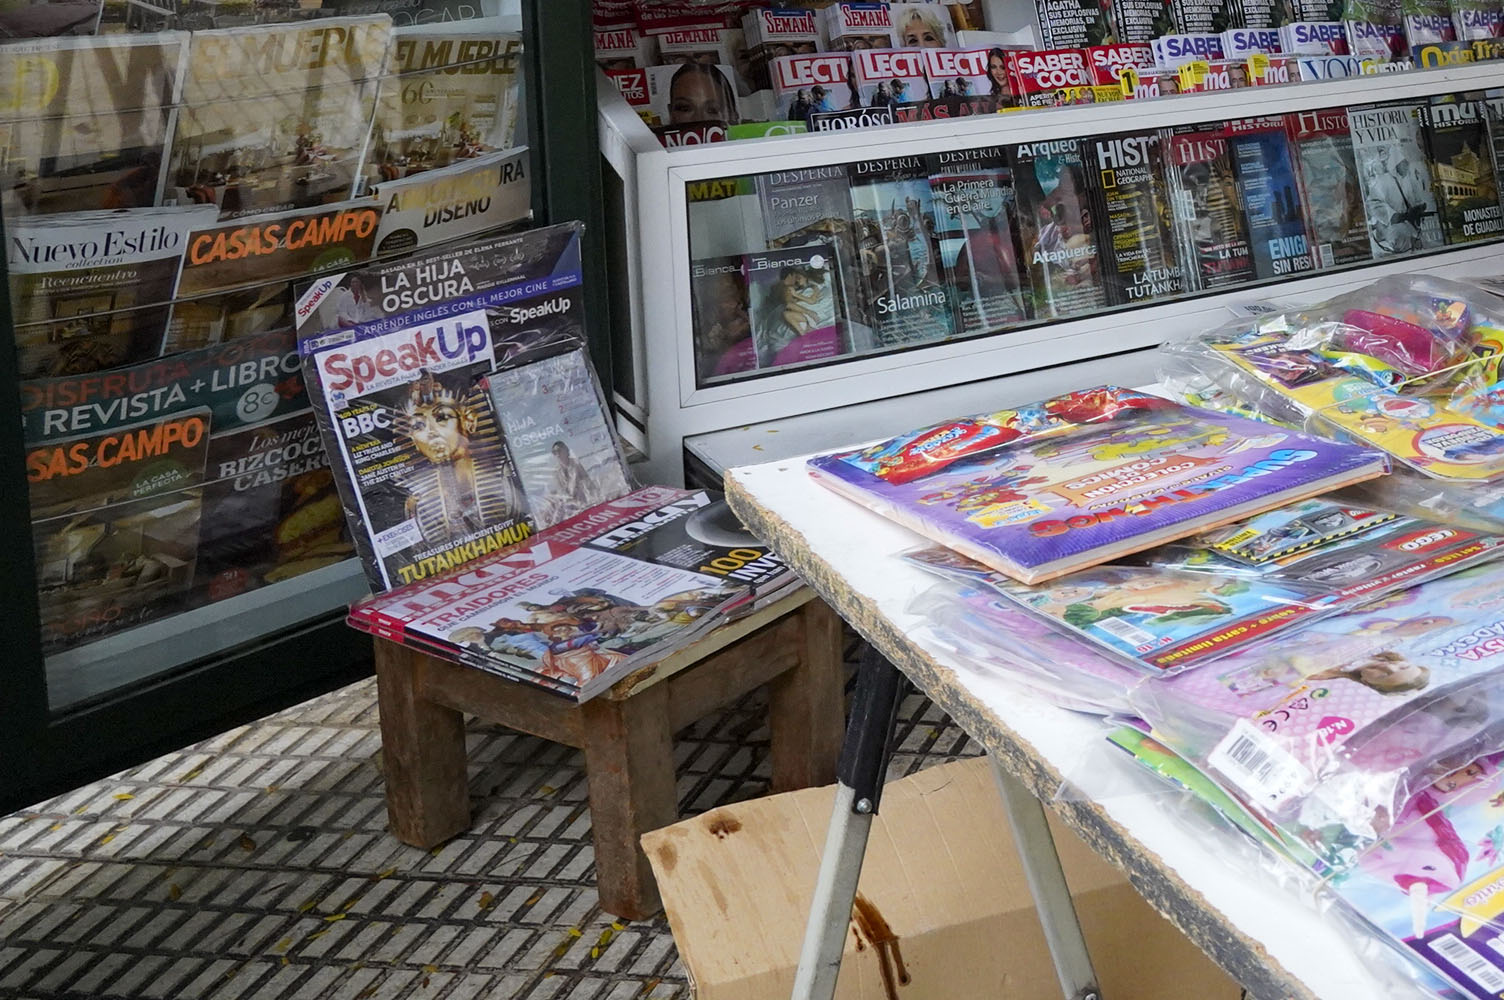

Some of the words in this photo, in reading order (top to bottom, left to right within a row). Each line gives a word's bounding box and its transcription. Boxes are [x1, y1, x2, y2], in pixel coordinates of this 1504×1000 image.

[841, 3, 891, 28] SEMANA
[1048, 0, 1081, 11] ÁGATHA
[1049, 10, 1063, 20] SUS
[764, 11, 817, 35] SEMANA
[420, 40, 520, 77] MUEBLE
[1017, 53, 1083, 76] SABER
[1352, 113, 1409, 132] HISTORIA
[1364, 126, 1402, 146] VIDA
[770, 192, 819, 210] Panzer
[9, 237, 99, 265] Nuevo
[103, 225, 179, 258] Estilo
[190, 224, 281, 266] CASAS
[285, 209, 377, 250] CAMPO
[380, 274, 410, 295] LA
[415, 258, 466, 286] HIJA
[756, 257, 802, 270] Bianca
[298, 279, 333, 318] SpeakUp
[362, 314, 412, 336] APRENDE
[413, 305, 450, 323] INGLÉS
[450, 300, 474, 314] CON
[476, 297, 488, 308] EL
[489, 288, 524, 304] MEJOR
[525, 280, 549, 295] CINE
[382, 279, 476, 313] OSCURA
[509, 296, 571, 325] SpeakUp
[876, 290, 947, 315] Salamina
[324, 321, 487, 395] SpeakUp
[43, 383, 186, 436] REVISTA
[341, 408, 392, 439] BBC
[96, 416, 204, 469] CAMPO
[1188, 448, 1318, 493] SUPER
[398, 521, 534, 584] TUTANKHAMUN
[1400, 528, 1456, 552] LEGO
[702, 547, 763, 578] 100
[420, 572, 549, 628] TRAIDORES
